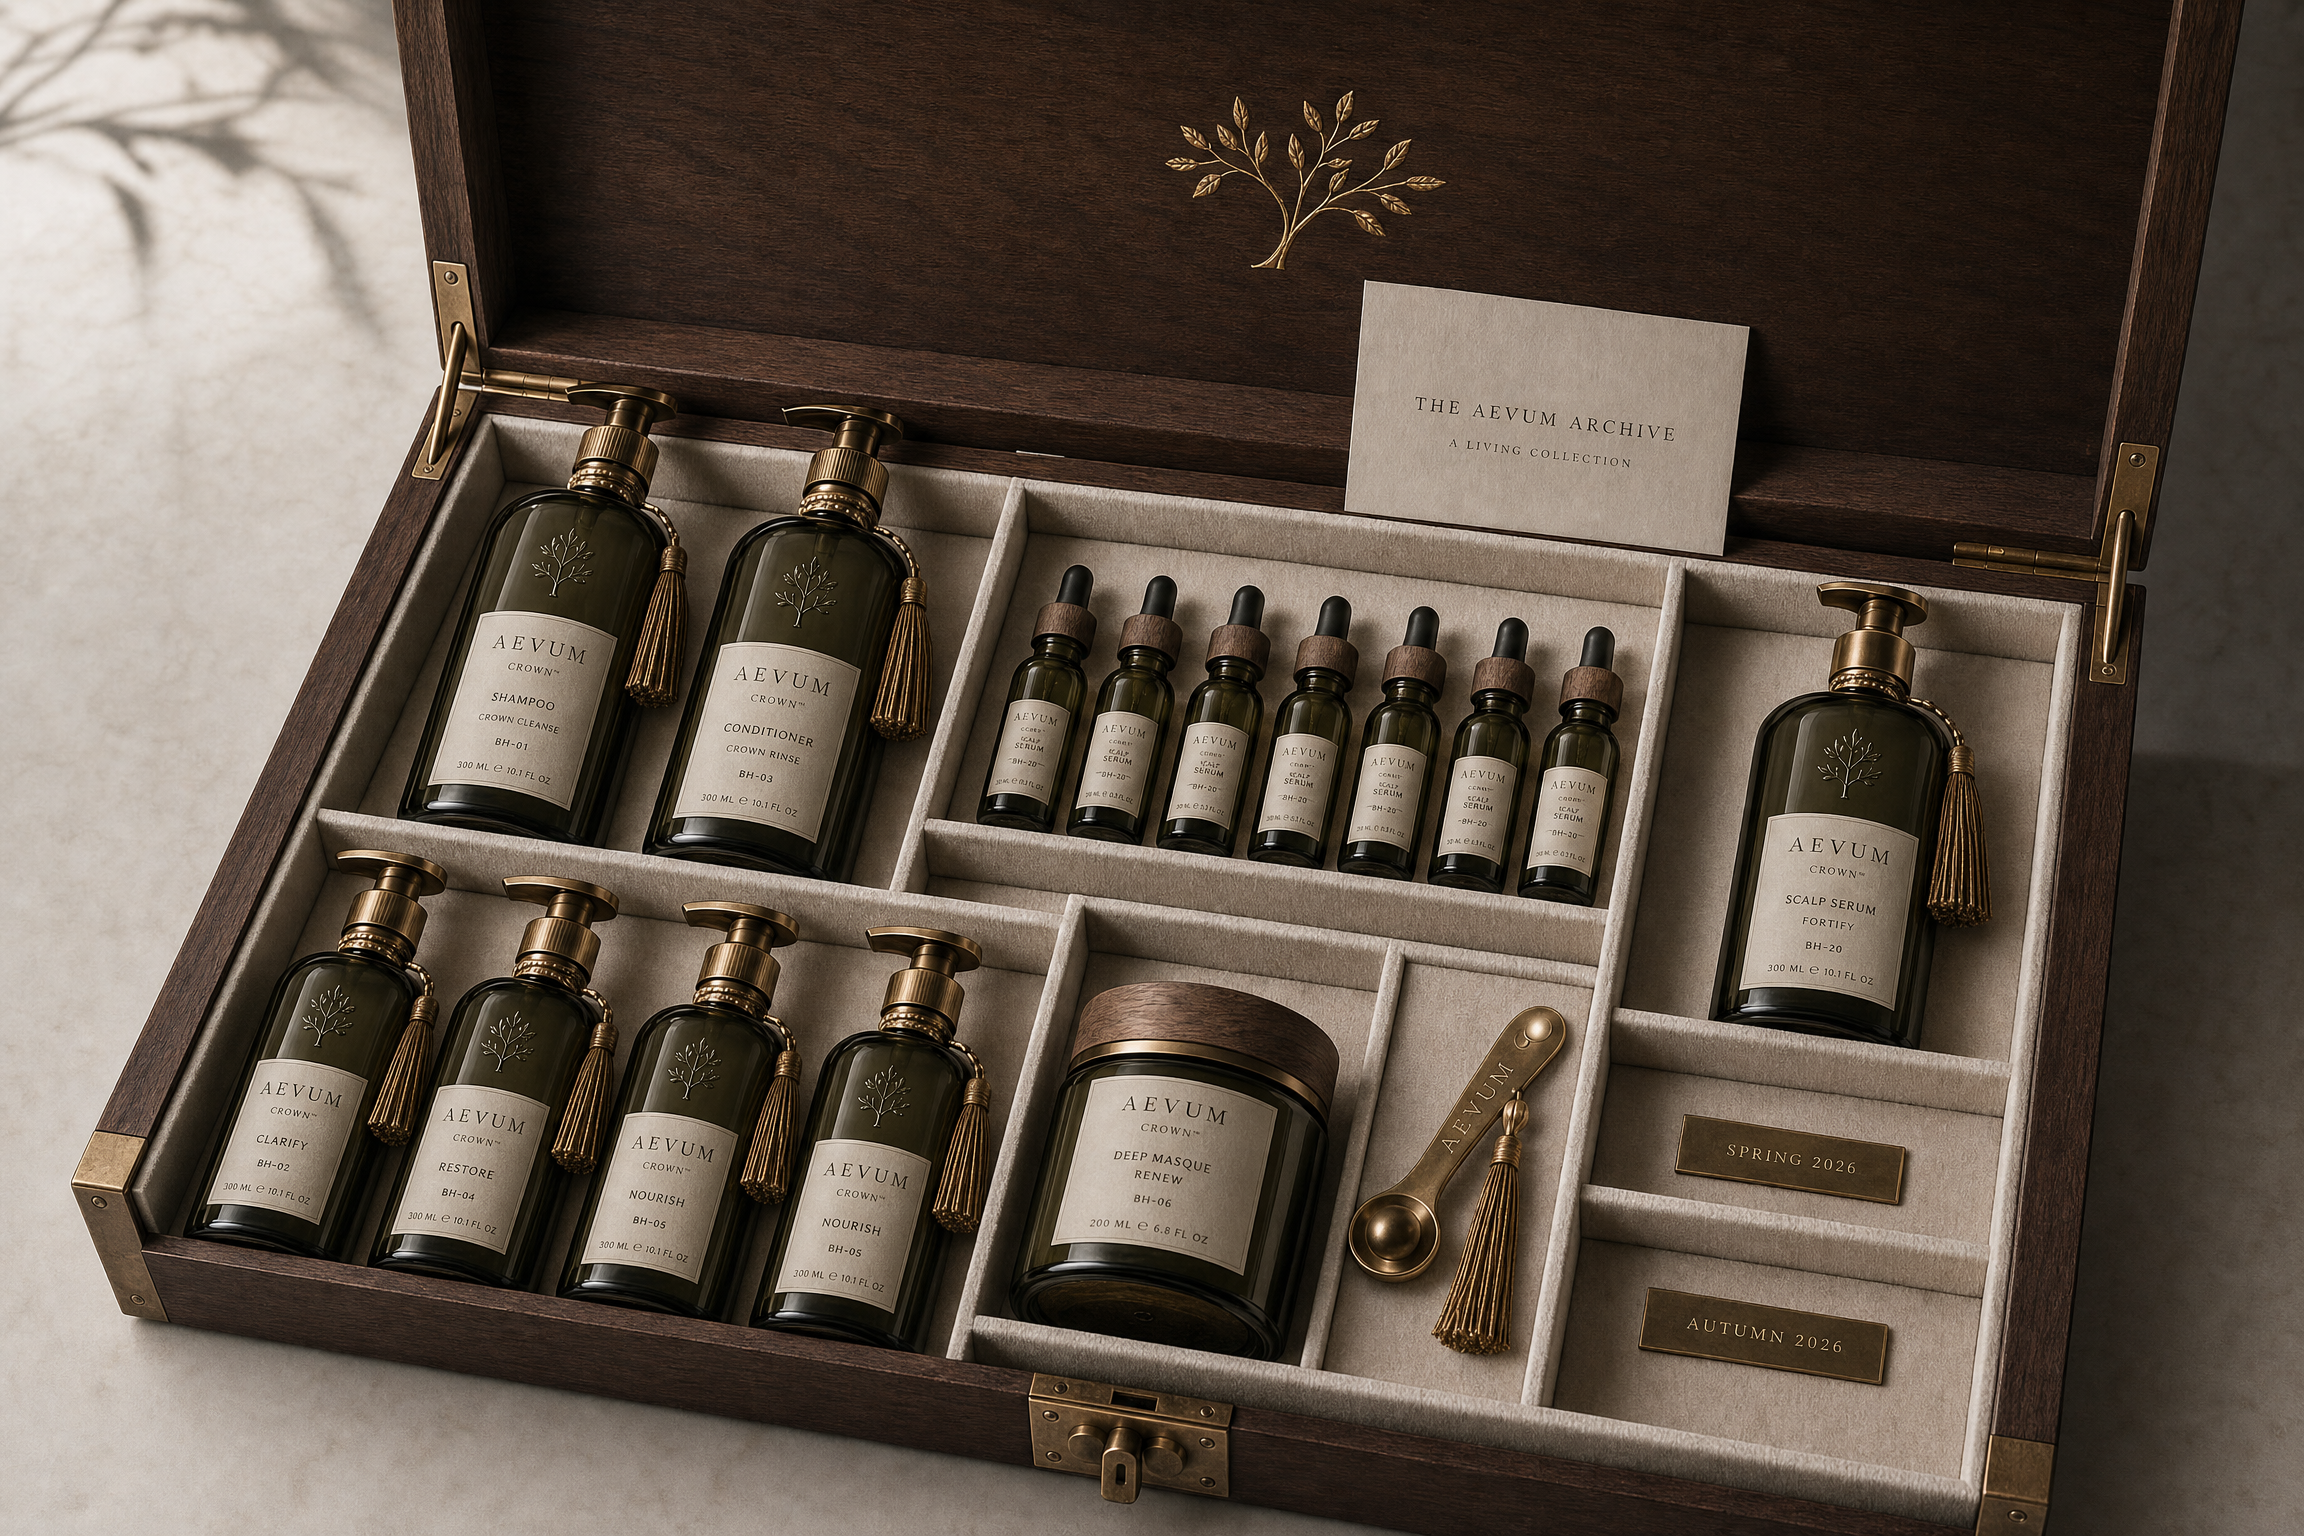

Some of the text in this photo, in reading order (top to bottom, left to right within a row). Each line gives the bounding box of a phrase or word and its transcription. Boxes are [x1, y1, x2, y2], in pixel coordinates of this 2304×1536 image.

[1415, 396, 1676, 442] THE AEVUM ARCHIVE
[1449, 439, 1632, 468] A LIVING COLLECTION
[492, 635, 587, 665] AEVUM
[734, 666, 831, 697] AEVUM
[491, 693, 555, 711] SHAMPOO
[479, 714, 560, 734] CROWN CLEANSE
[1014, 712, 1058, 727] AEVUM
[724, 723, 814, 748] CONDITIONER
[1102, 724, 1146, 739] AEVUM
[495, 738, 528, 751] BH-01
[1015, 742, 1044, 752] SERUM
[1193, 736, 1237, 750] AEVUM
[726, 745, 800, 765] CROWN RINSE
[1103, 755, 1132, 766] SERUM
[1282, 747, 1326, 761] AEVUM
[1371, 757, 1415, 771] AEVUM
[476, 763, 489, 771] ML
[507, 767, 522, 776] 10.1
[525, 771, 535, 780] FL
[538, 775, 551, 785] OZ
[739, 770, 773, 783] BH-03
[1284, 777, 1314, 788] SERUM
[1461, 770, 1505, 784] AEVUM
[1373, 789, 1403, 799] SERUM
[1551, 781, 1596, 795] AEVUM
[720, 795, 734, 803] ML
[752, 799, 768, 809] 10.1
[771, 803, 781, 812] FL
[785, 807, 798, 817] OZ
[1463, 802, 1493, 812] SERUM
[1554, 812, 1583, 823] SERUM
[1788, 837, 1890, 865] AEVUM
[1786, 895, 1877, 916] SCALP SERUM
[1802, 917, 1854, 931] FORTIFY
[1805, 941, 1842, 953] BH-20
[1767, 964, 1785, 972] 300
[1789, 965, 1804, 973] ML
[1824, 968, 1841, 978] 10.1
[1844, 972, 1856, 981] FL
[1860, 976, 1874, 985] OZ
[260, 1082, 342, 1108] AEVUM
[1122, 1096, 1228, 1126] AEVUM
[1441, 1062, 1514, 1154] AEVUM
[443, 1108, 526, 1135] AEVUM
[256, 1134, 308, 1150] CLARIFY
[631, 1136, 715, 1163] AEVUM
[257, 1159, 290, 1172] BH-02
[1114, 1151, 1212, 1174] DEEP MASQUE
[1726, 1143, 1856, 1174] SPRING 2026
[439, 1162, 494, 1180] RESTORE
[823, 1162, 909, 1190] AEVUM
[1134, 1170, 1183, 1185] RENEW
[268, 1188, 284, 1196] 10.1
[285, 1192, 295, 1200] FL
[298, 1196, 310, 1205] OZ
[442, 1188, 475, 1200] BH-04
[629, 1190, 685, 1208] NOURISH
[1134, 1195, 1172, 1208] BH-06
[408, 1212, 422, 1220] 300
[425, 1213, 437, 1221] ML
[454, 1217, 469, 1226] 10.1
[471, 1221, 481, 1230] FL
[485, 1225, 497, 1235] OZ
[633, 1216, 666, 1229] BH-05
[822, 1218, 881, 1236] NOURISH
[1090, 1219, 1109, 1227] 200
[1114, 1220, 1131, 1228] ML
[1153, 1224, 1170, 1235] 6.8
[1174, 1229, 1187, 1239] FL
[1192, 1233, 1208, 1245] OZ
[616, 1242, 629, 1250] ML
[645, 1246, 660, 1255] 10.1
[663, 1250, 673, 1258] FL
[676, 1253, 688, 1263] OZ
[828, 1244, 862, 1257] BH-05
[793, 1269, 809, 1277] 300
[811, 1270, 824, 1279] ML
[841, 1274, 856, 1284] 10.1
[859, 1278, 869, 1287] FL
[872, 1282, 884, 1292] OZ
[1686, 1317, 1842, 1353] AUTUMN 2026
